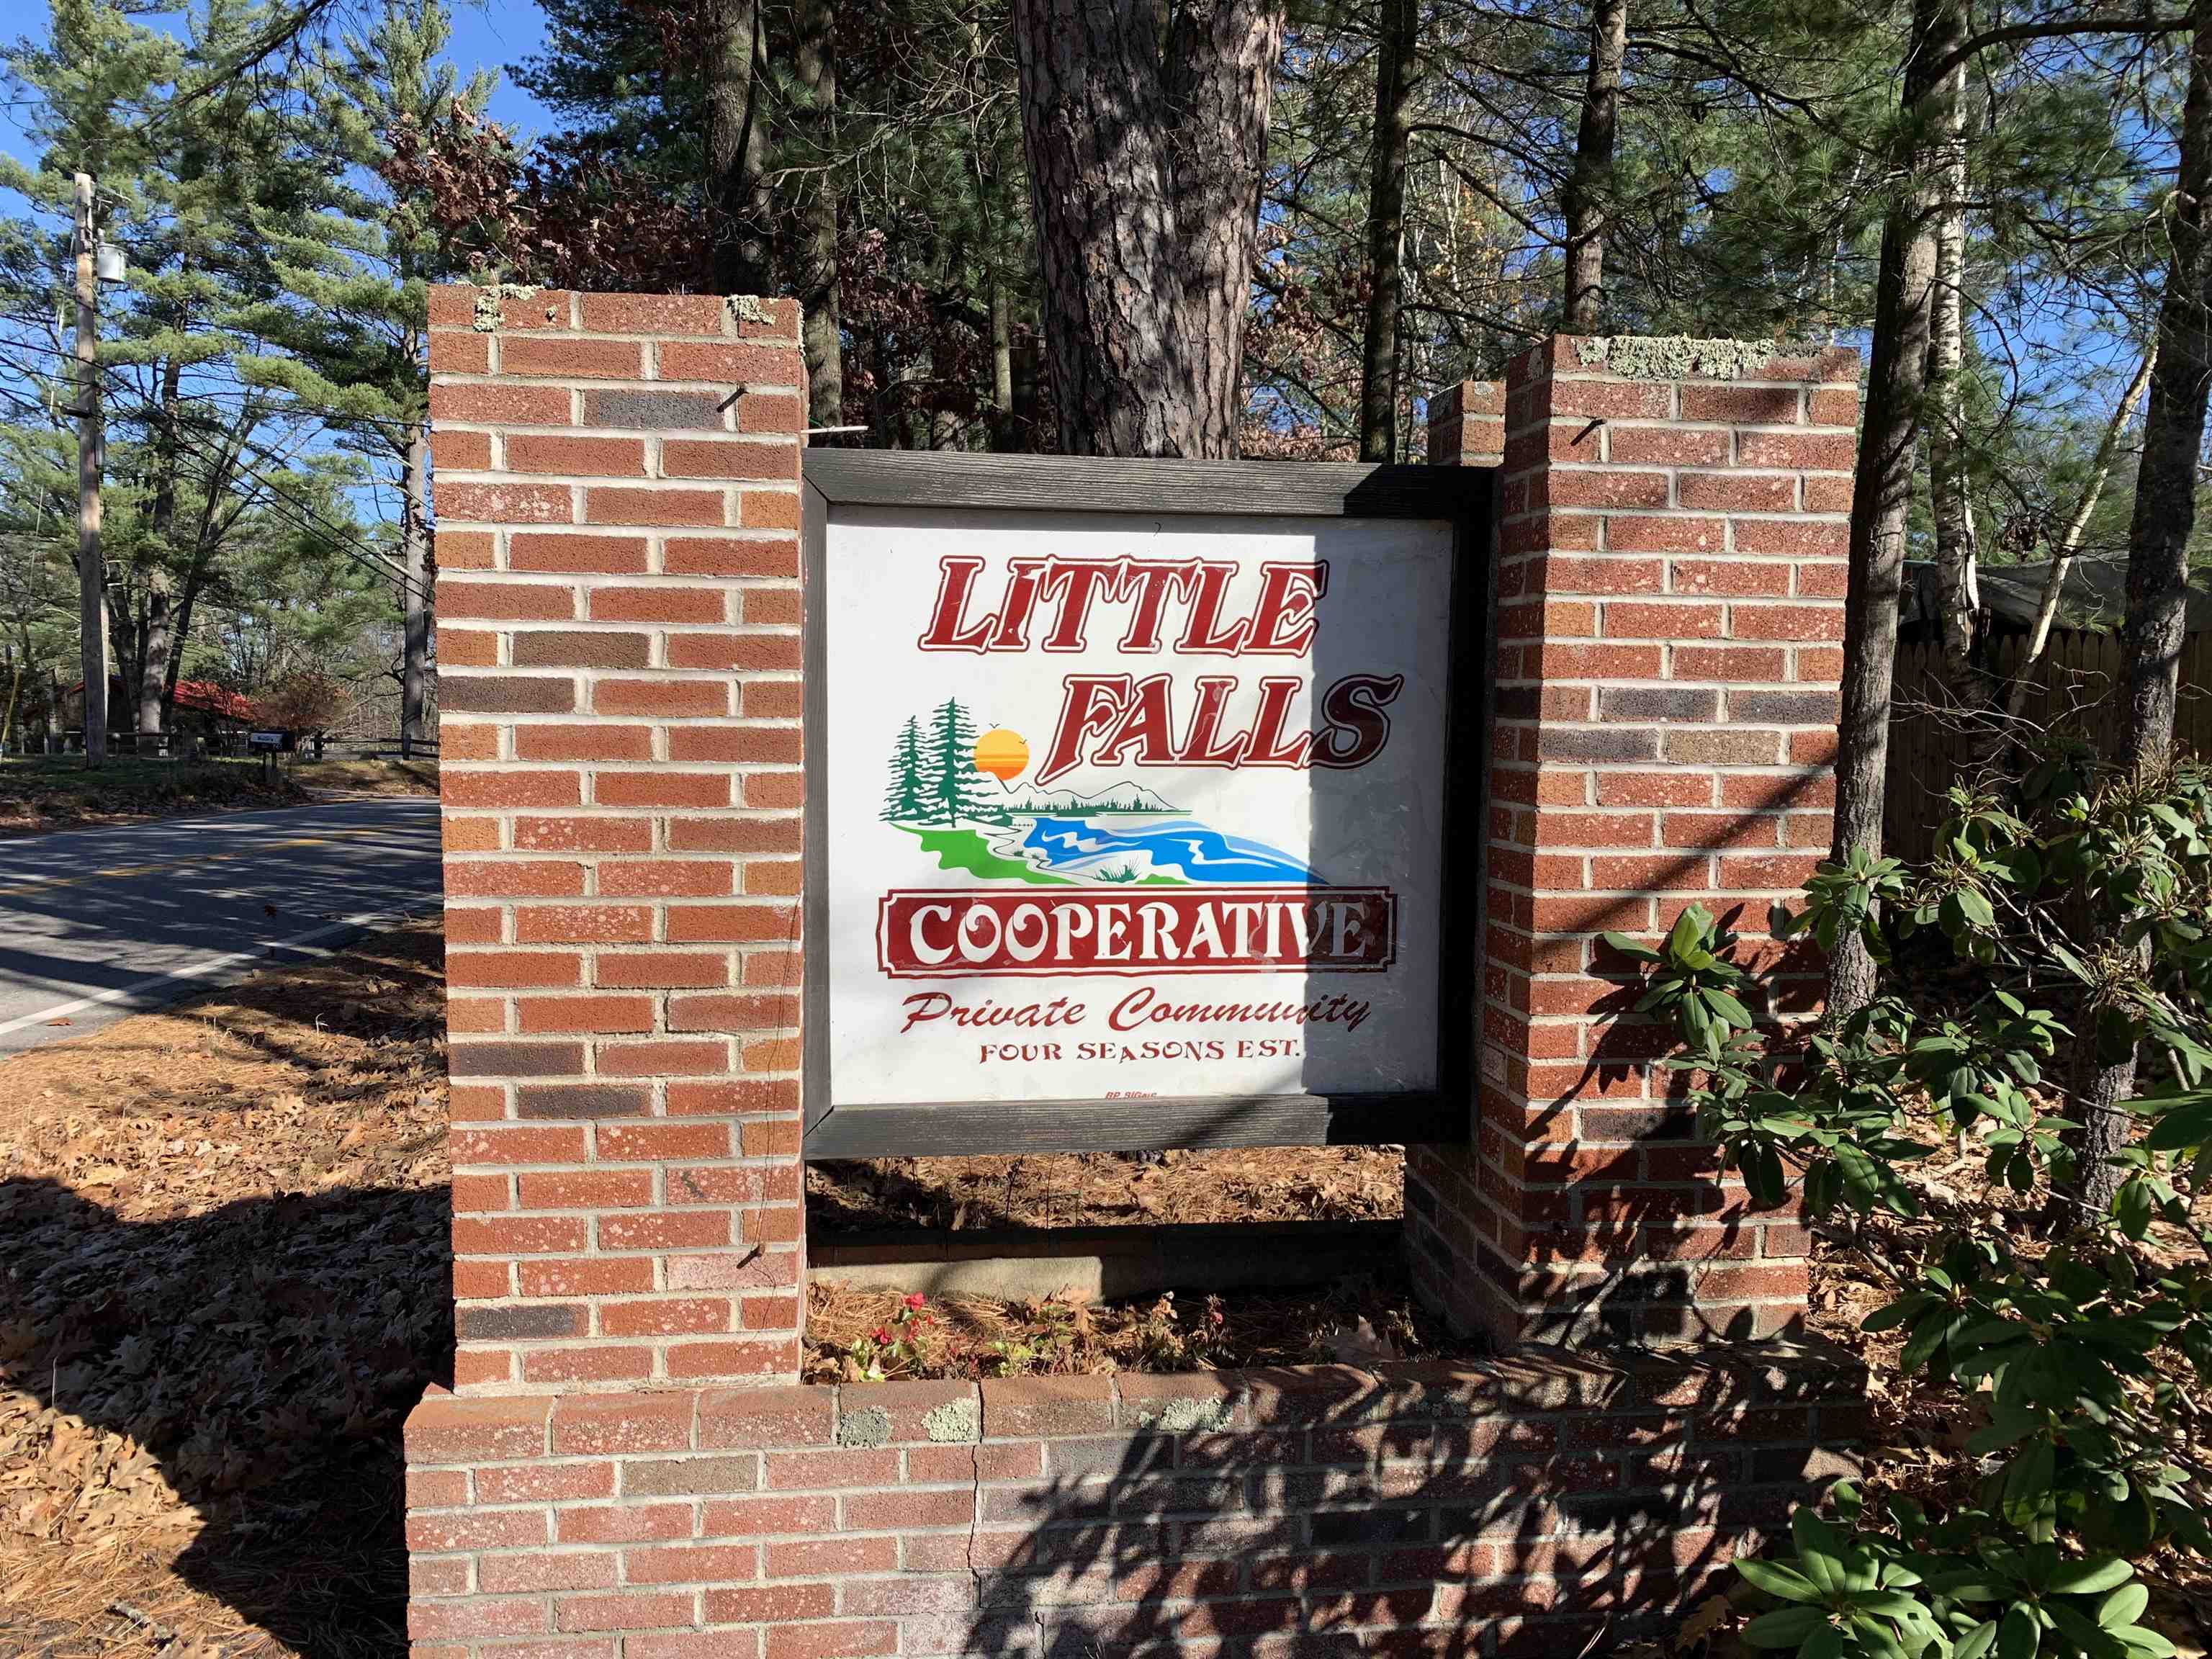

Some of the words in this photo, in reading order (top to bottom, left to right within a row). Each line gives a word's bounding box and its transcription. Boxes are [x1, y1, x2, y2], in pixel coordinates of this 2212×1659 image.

[918, 554, 1329, 655] LITTLE
[1035, 673, 1405, 786] FALLS
[909, 900, 1367, 965] COOPERATIVE
[900, 991, 1086, 1034] Private
[1107, 986, 1372, 1033] Community
[979, 1042, 1063, 1064] FOUR
[1076, 1040, 1226, 1064] SEASONS
[1236, 1038, 1301, 1059] EST.
